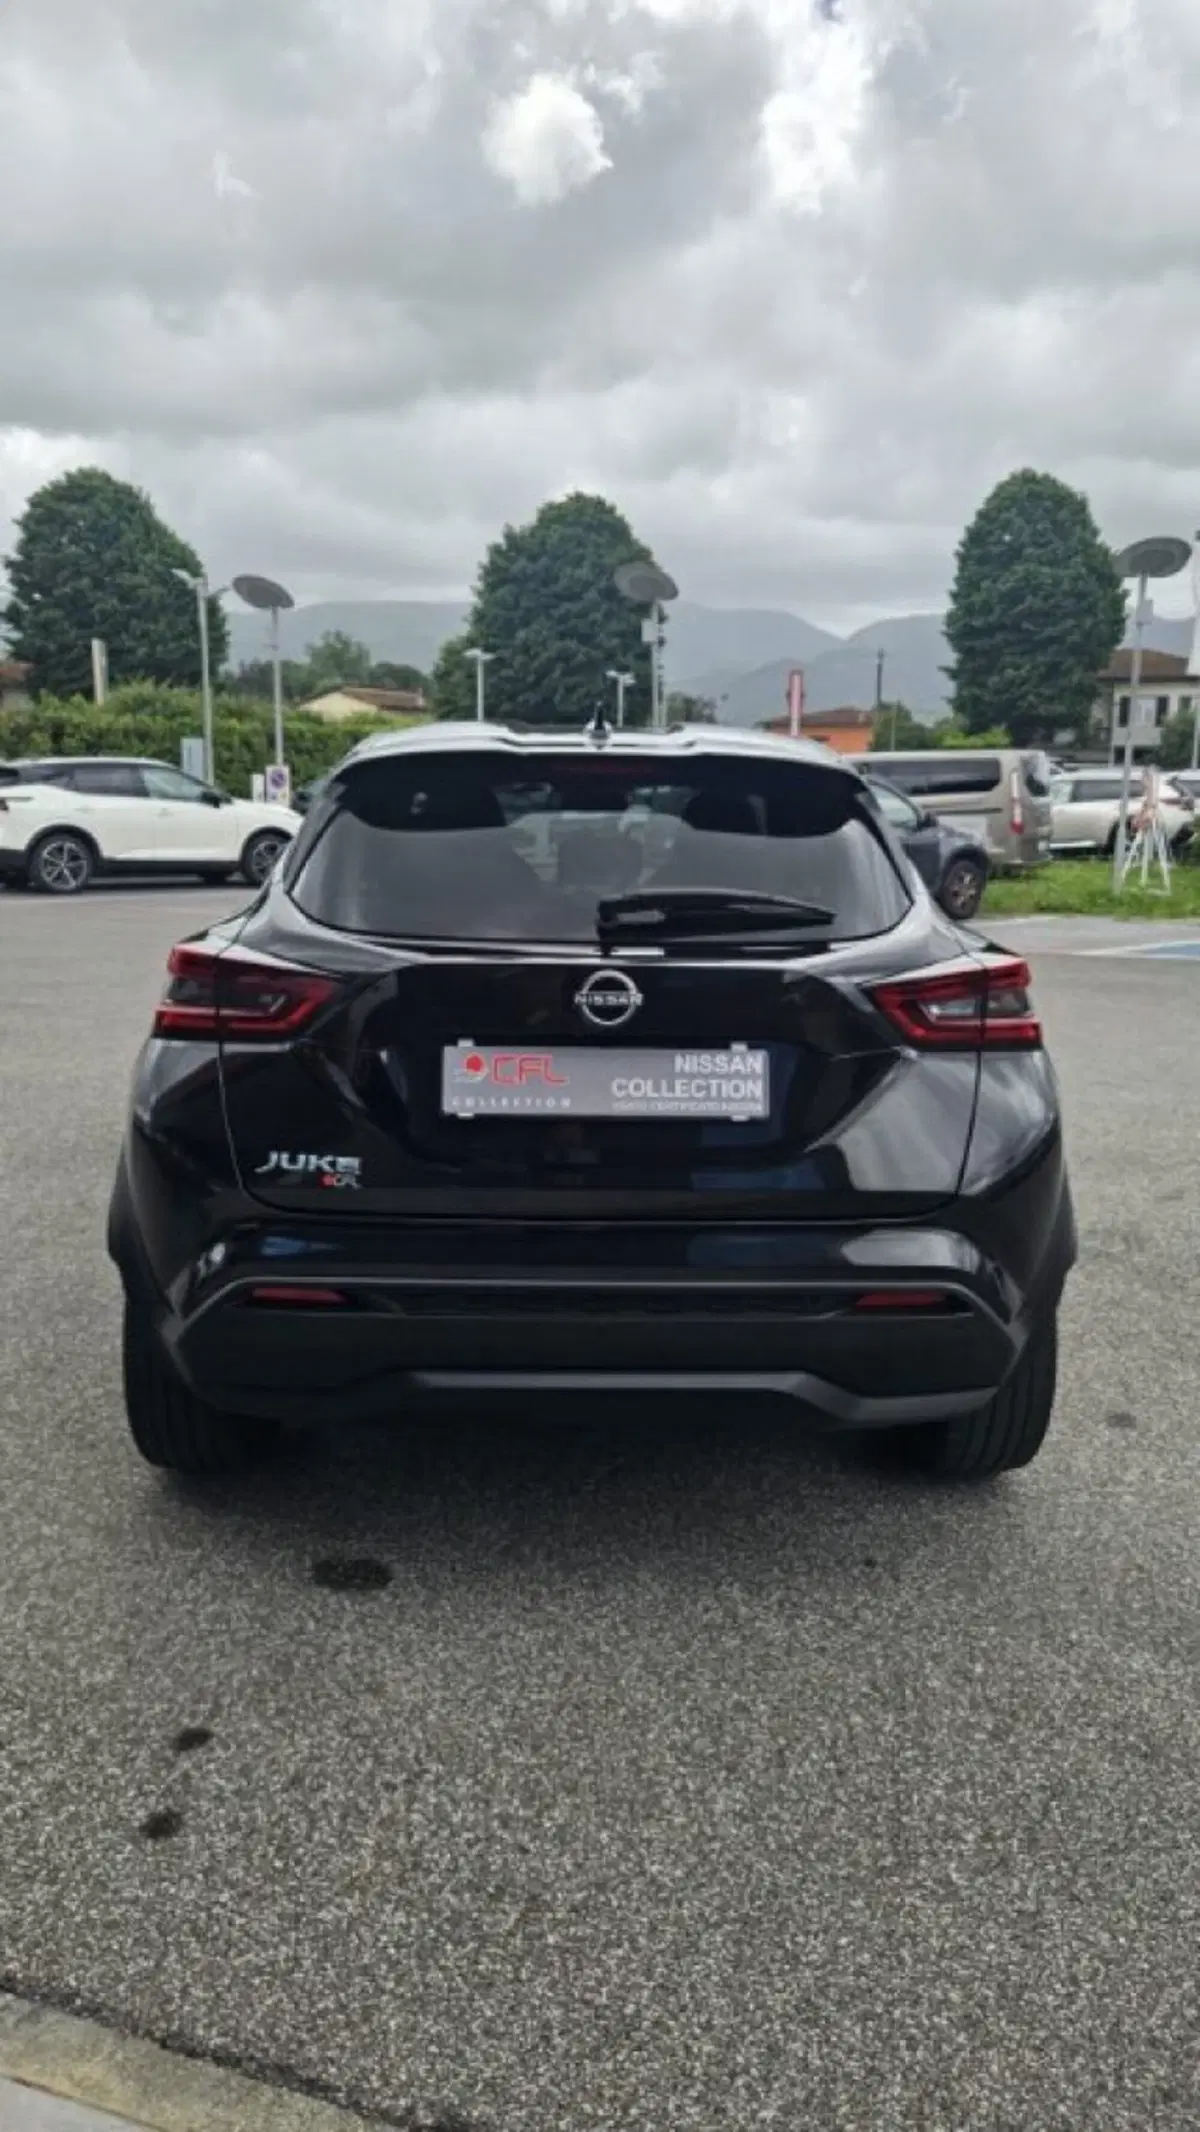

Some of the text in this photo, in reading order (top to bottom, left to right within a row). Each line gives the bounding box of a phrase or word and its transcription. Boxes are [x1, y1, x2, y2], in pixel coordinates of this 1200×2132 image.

[574, 994, 643, 1006] NISSAN
[492, 1053, 569, 1086] CFL
[674, 1053, 763, 1074] NISSAN
[611, 1077, 763, 1098] COLLECTION
[254, 1151, 361, 1175] JUKE
